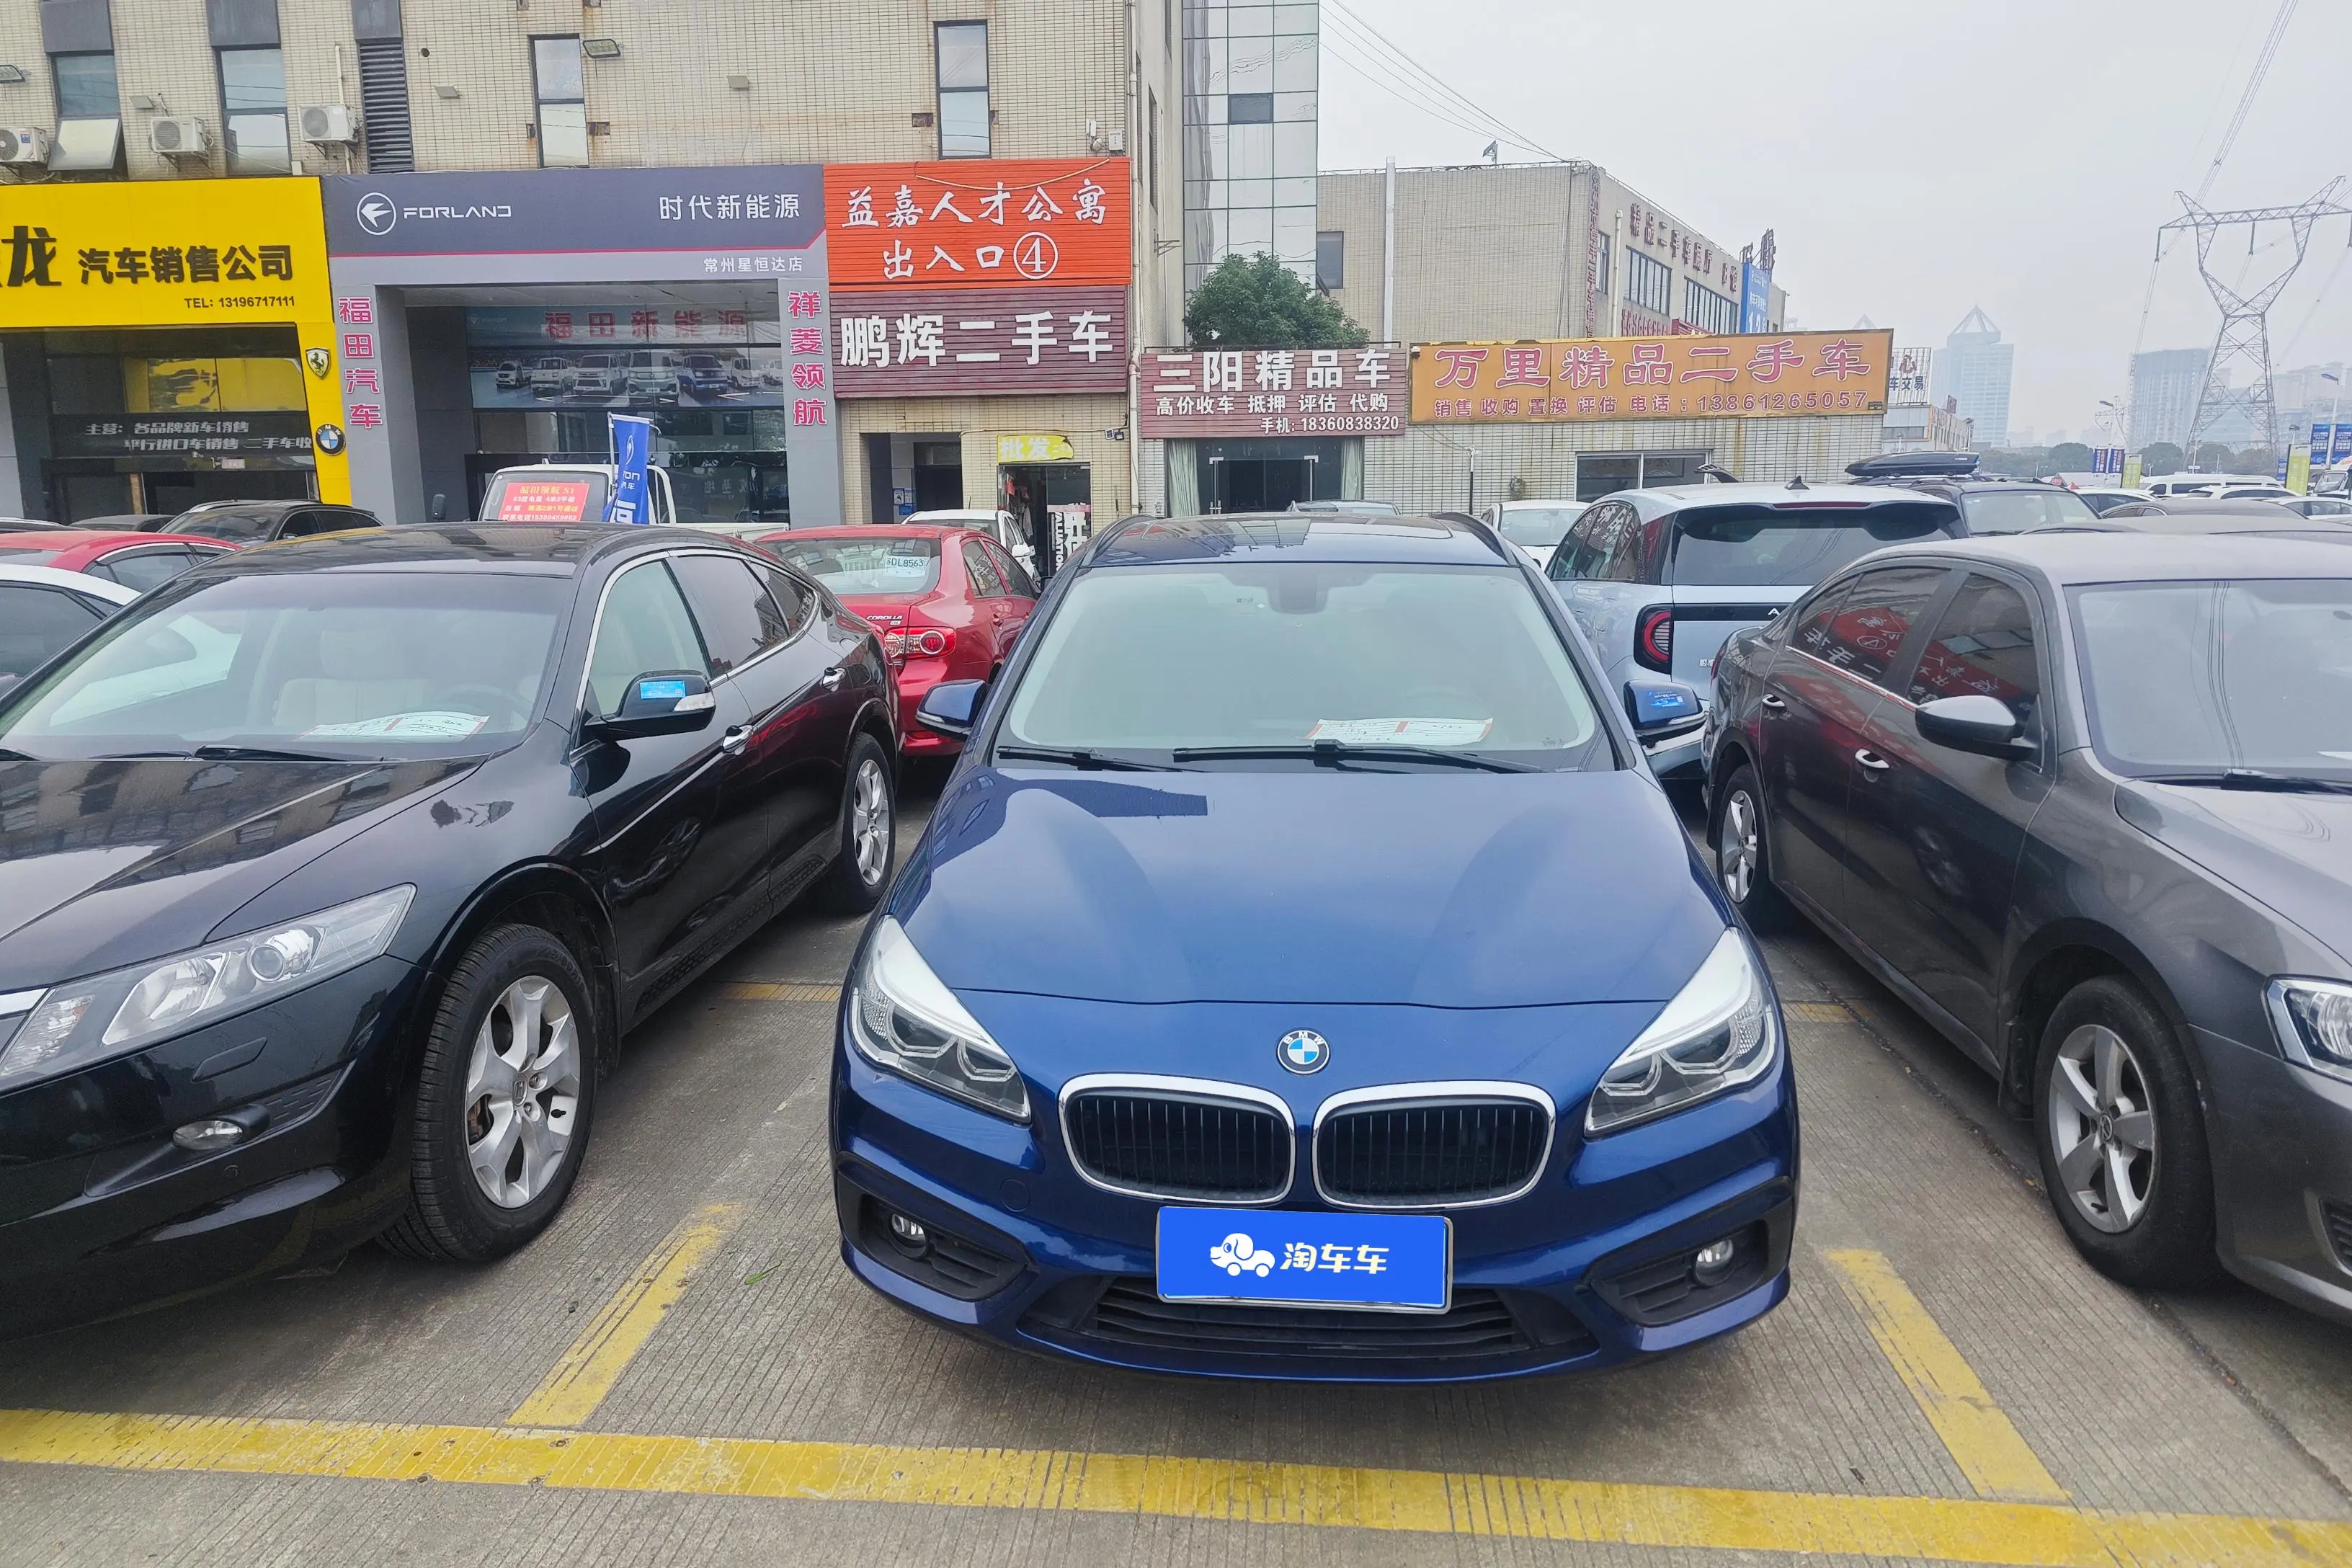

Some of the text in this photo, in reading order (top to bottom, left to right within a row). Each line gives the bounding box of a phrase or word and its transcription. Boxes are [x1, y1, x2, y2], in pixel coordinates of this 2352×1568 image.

[404, 205, 512, 220] FORLAND
[659, 193, 801, 220] 时代新能源
[841, 178, 1106, 228] 益嘉人才公寓
[0, 225, 62, 288] 龙
[79, 245, 293, 284] 汽车销售公司
[704, 257, 803, 274] 常州星恒达店
[184, 296, 295, 308] TEL: 13196717111
[545, 310, 747, 339] 福田新能源
[840, 309, 1113, 368] 鹏辉二手车
[337, 297, 384, 429] 福田汽车
[788, 291, 828, 427] 祥菱领航
[1154, 349, 1391, 393] 三阳精品车
[1435, 339, 1871, 390] 万里精品二手车
[1155, 393, 1388, 416] 高价收车 抵押 评估 代购
[1435, 397, 1472, 418] 销售
[1481, 396, 1519, 416] 收购
[1529, 396, 1567, 415] 置换
[1578, 395, 1617, 414] 评估
[1698, 391, 1868, 412] 13861265057
[1260, 416, 1399, 435] 手机: 18360838320
[1283, 1031, 1324, 1045] BMW
